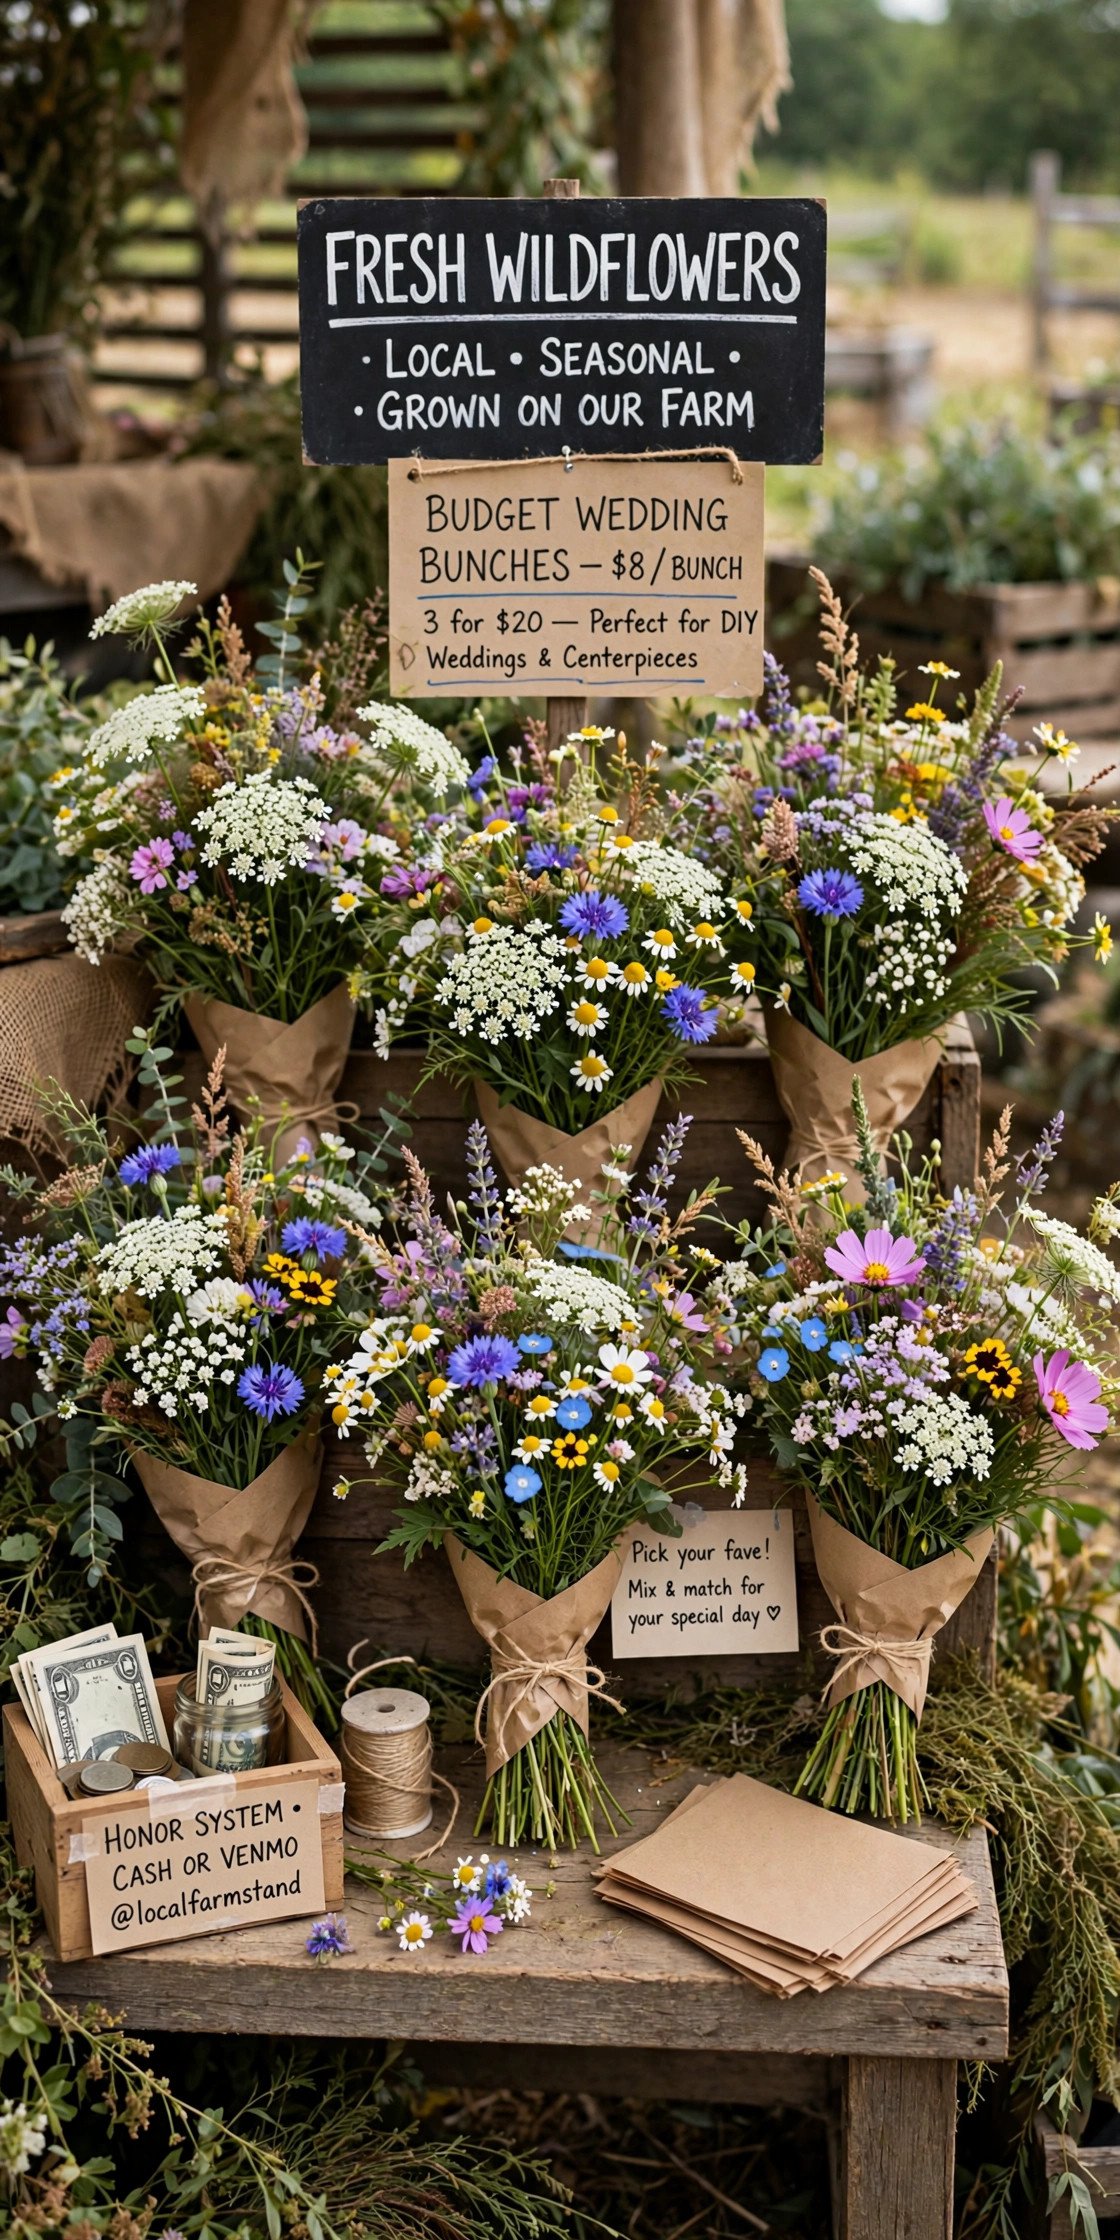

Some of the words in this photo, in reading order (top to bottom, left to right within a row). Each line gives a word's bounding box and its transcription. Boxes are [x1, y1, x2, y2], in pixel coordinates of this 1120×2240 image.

[325, 230, 466, 306] FRESH
[485, 230, 801, 304] WILDFLOWERS
[385, 338, 496, 379] LOCAL
[539, 336, 715, 377] SEASONAL
[377, 390, 501, 431] GROWN
[517, 393, 562, 427] ON
[578, 391, 644, 427] OUR
[661, 387, 755, 429] FARM
[425, 493, 560, 533] BUDGET
[575, 495, 729, 532] WEDDING
[418, 546, 570, 584] BUNCHES
[423, 609, 439, 635] 3
[449, 607, 485, 634] for
[496, 608, 543, 636] $20
[590, 607, 669, 634] Perfect
[677, 607, 711, 634] for
[721, 609, 759, 635] DIY
[426, 644, 527, 679] Weddings
[538, 647, 552, 668] &
[563, 644, 698, 677] Centerpieces
[631, 1539, 669, 1564] Pick
[676, 1547, 716, 1570] your
[724, 1537, 770, 1561] fave!
[628, 1578, 657, 1599] Mix
[665, 1580, 676, 1597] &
[683, 1577, 733, 1597] match
[740, 1574, 766, 1596] for
[628, 1613, 664, 1635] your
[671, 1605, 724, 1632] special
[731, 1603, 761, 1630] day
[104, 1818, 185, 1855] HONOR
[194, 1799, 284, 1837] SYSTEM
[112, 1858, 172, 1892] CASH
[183, 1852, 212, 1876] OR
[219, 1835, 299, 1870] VENMO
[111, 1869, 302, 1931] @localfarmstand
